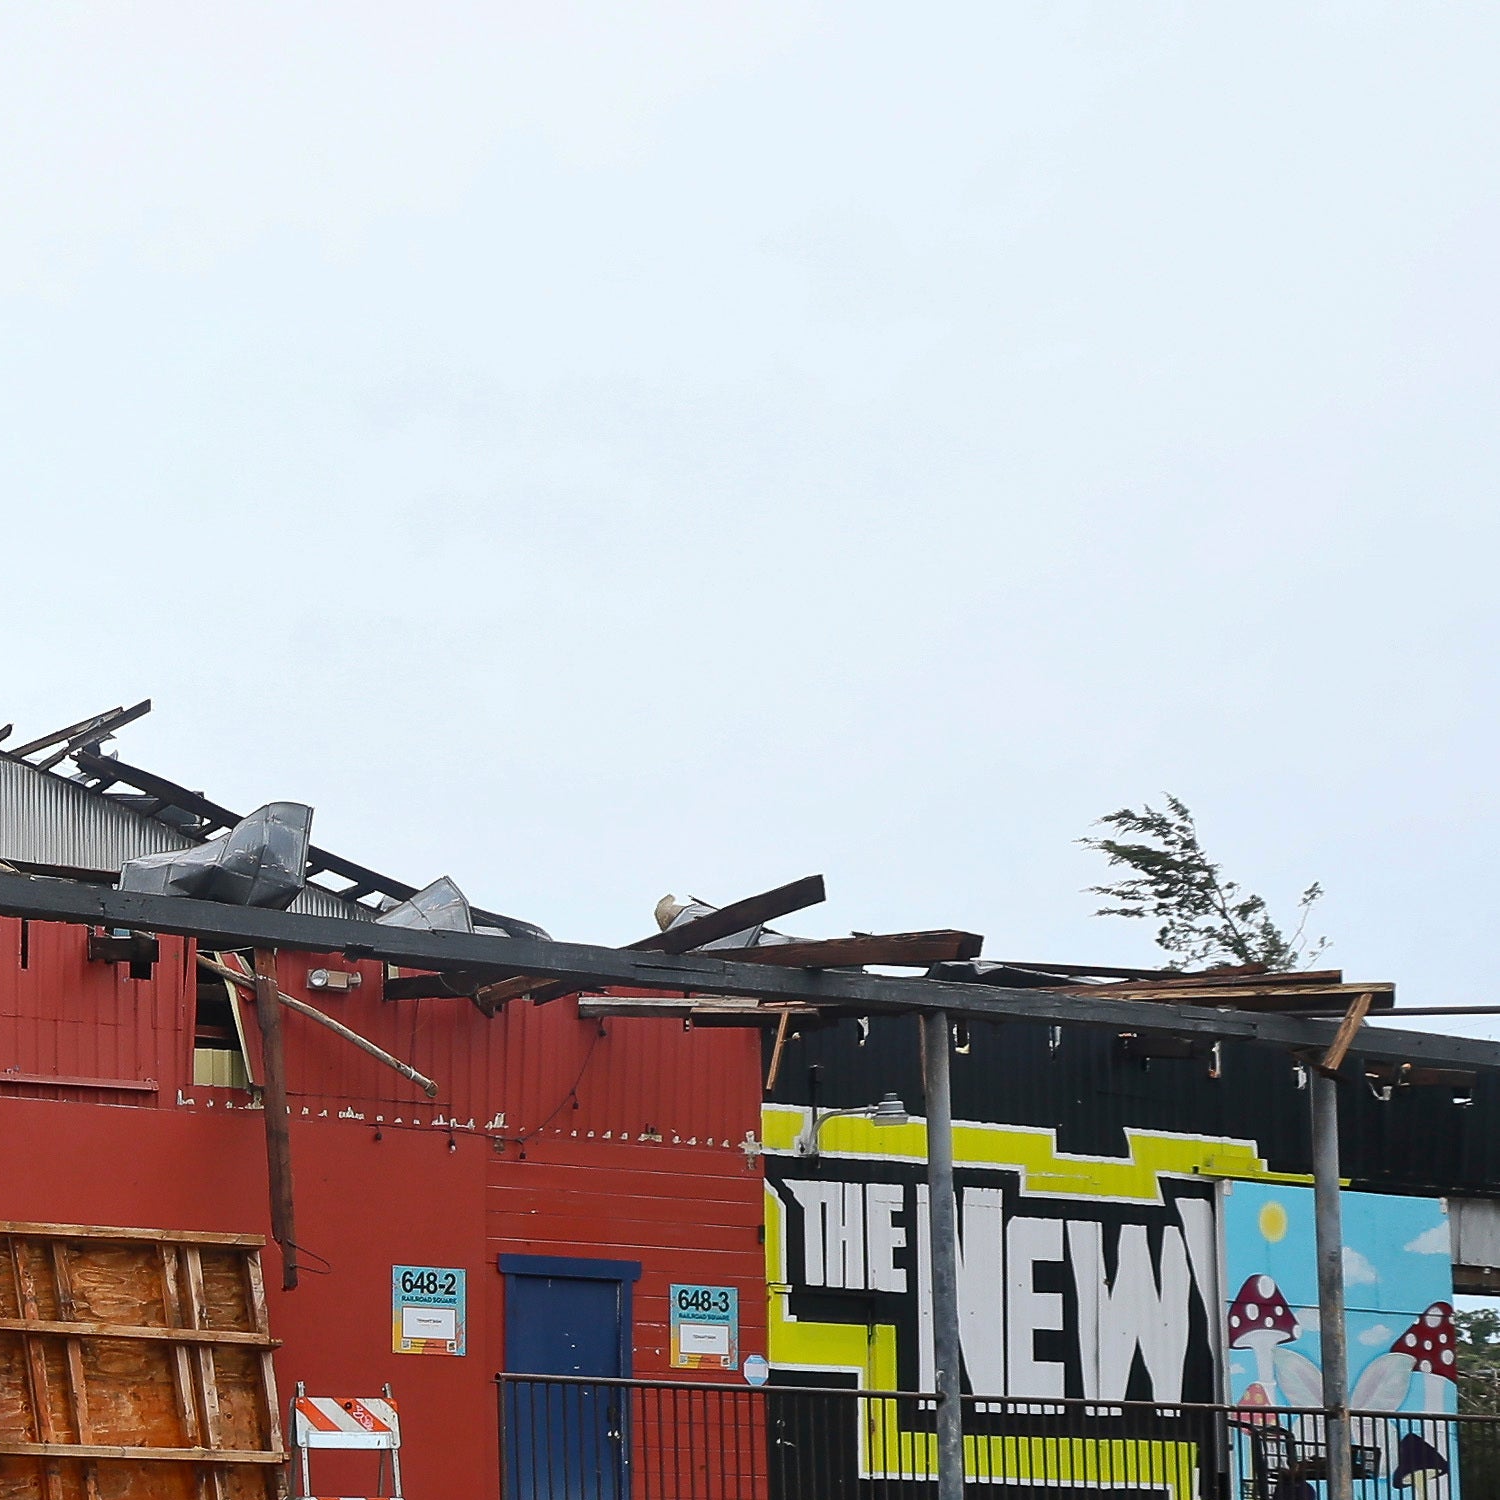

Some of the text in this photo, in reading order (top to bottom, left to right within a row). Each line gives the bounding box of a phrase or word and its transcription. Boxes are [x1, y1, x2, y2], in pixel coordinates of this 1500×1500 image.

[782, 1178, 907, 1293] THE
[401, 1270, 456, 1295] 648-2
[401, 1295, 433, 1303] RAILROAD
[678, 1289, 730, 1313] 648-3
[915, 1182, 1191, 1417] NEW
